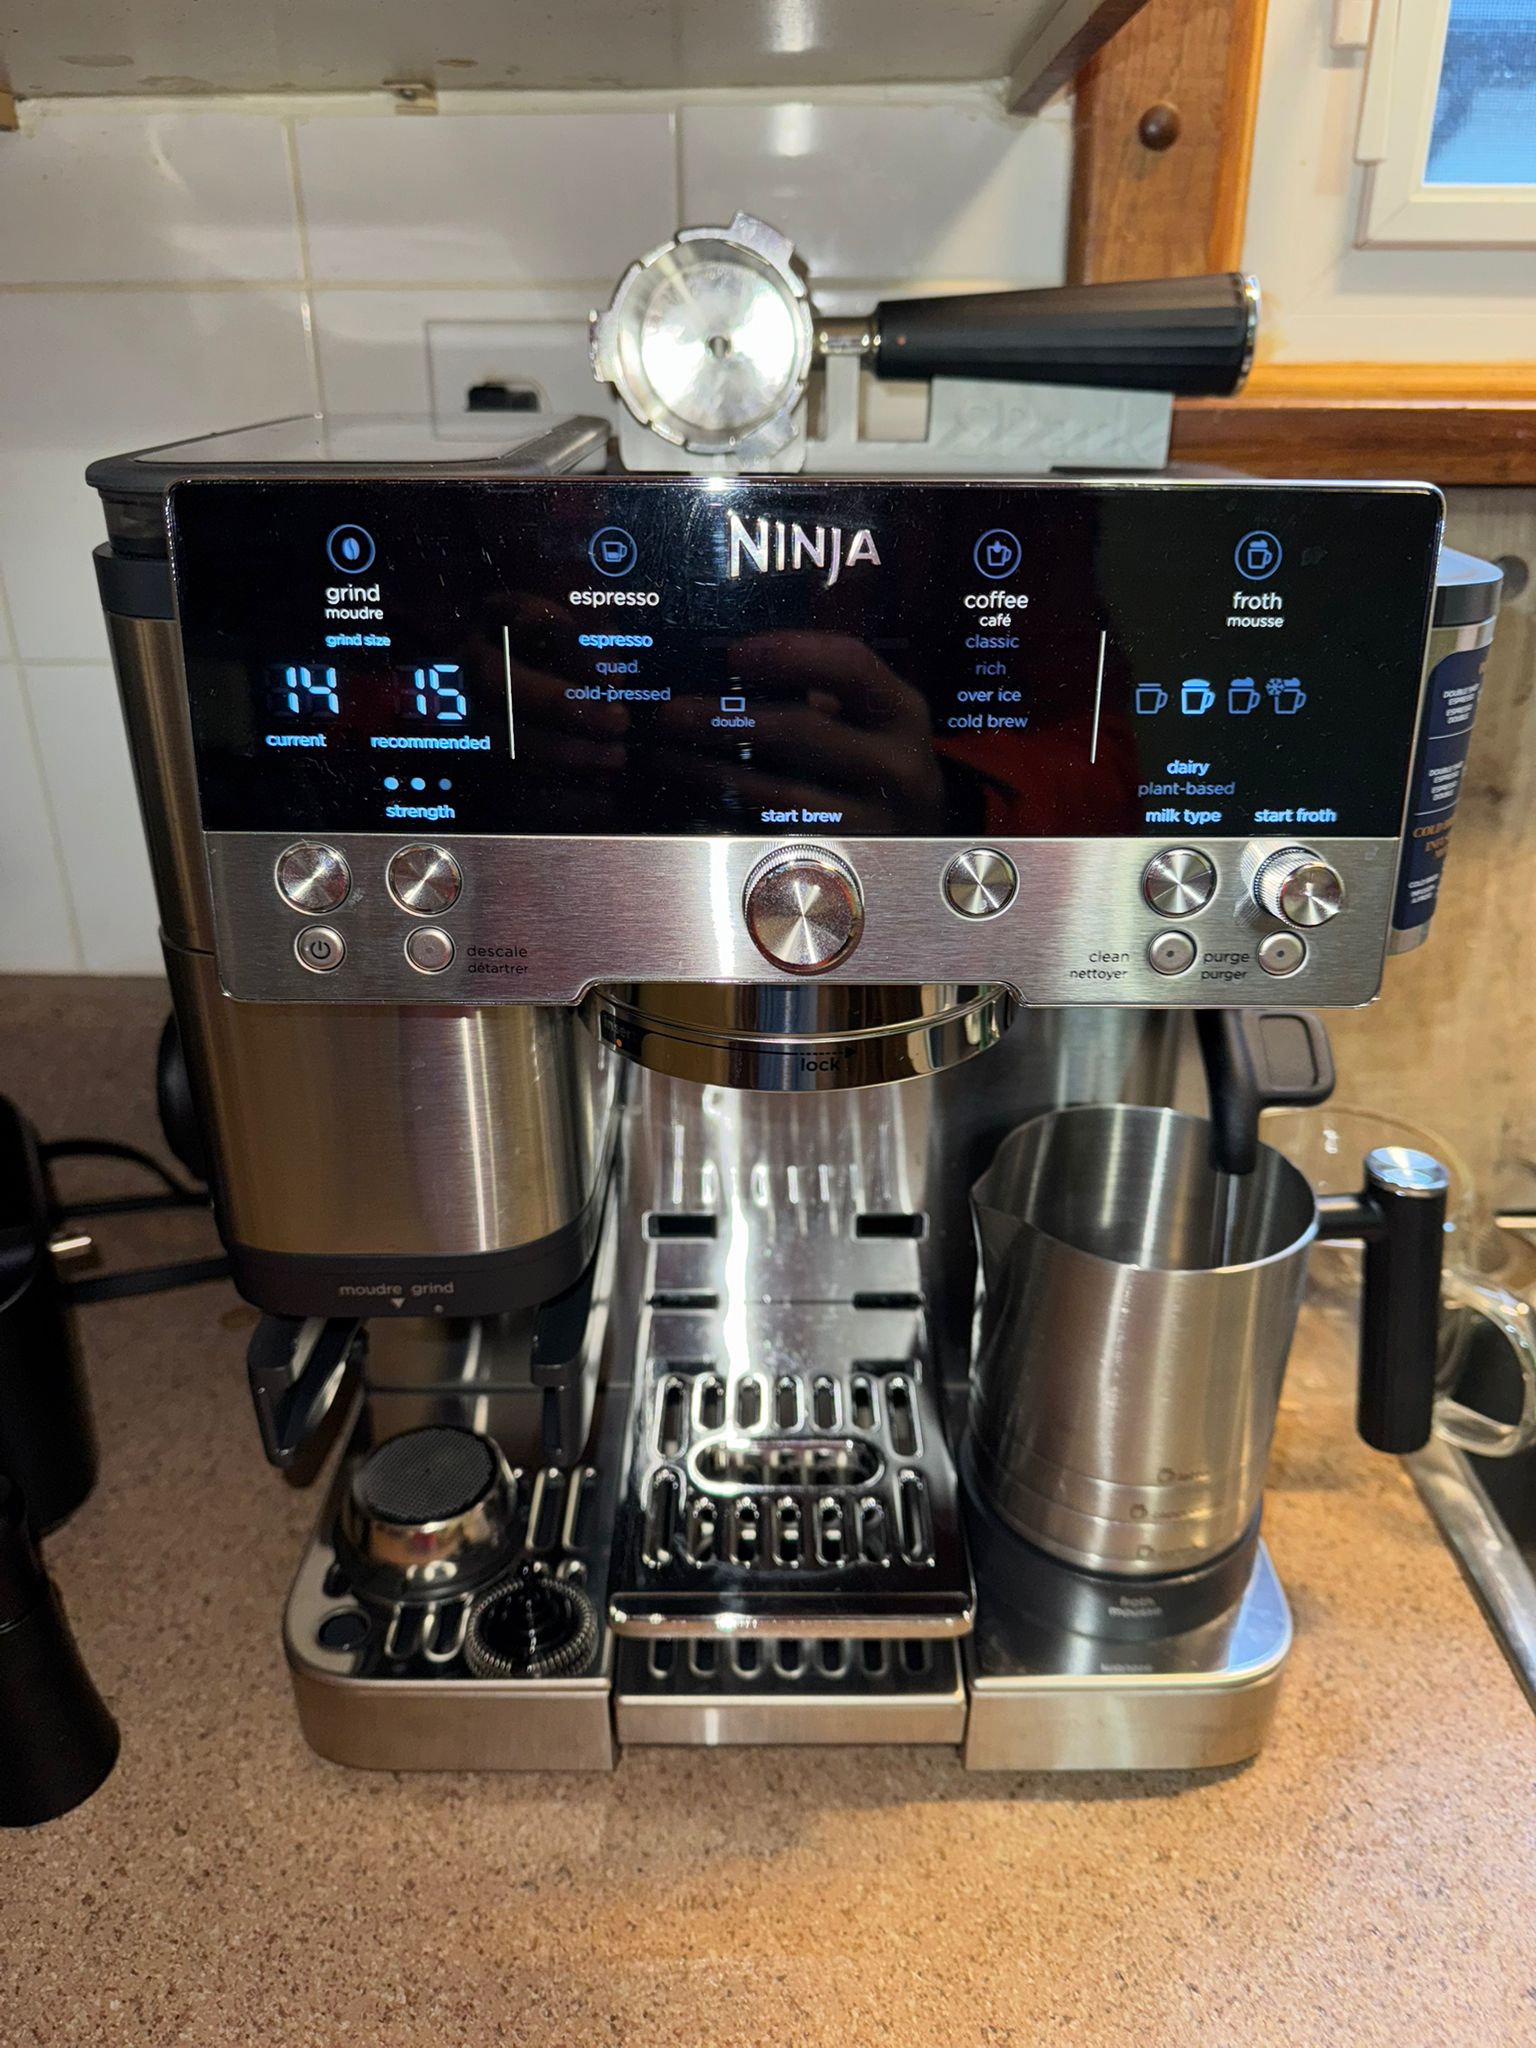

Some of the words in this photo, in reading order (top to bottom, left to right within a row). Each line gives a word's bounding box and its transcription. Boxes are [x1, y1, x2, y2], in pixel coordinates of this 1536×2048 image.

[727, 508, 881, 587] NINJA
[325, 582, 381, 604] grind
[569, 588, 660, 609] espresso
[964, 591, 1029, 609] coffee
[1232, 591, 1283, 610] froth
[324, 605, 384, 620] moudre
[979, 613, 1012, 627] café
[1226, 616, 1285, 628] mousse
[325, 633, 363, 649] grind
[364, 633, 391, 647] size
[578, 634, 654, 650] espresso
[965, 633, 1020, 649] classic
[596, 659, 638, 675] quad
[975, 660, 1006, 675] rich
[284, 666, 340, 715] 14
[413, 663, 468, 721] 15
[565, 684, 671, 703] cold-pressed
[957, 691, 993, 702] over
[997, 688, 1022, 702] ice
[711, 715, 756, 728] double
[948, 713, 983, 728] cold
[986, 713, 1028, 728] brew
[265, 733, 328, 748] current
[370, 734, 491, 750] recommended
[1166, 759, 1210, 777] dairy
[1138, 780, 1236, 797] plant-based
[386, 803, 456, 821] strength
[760, 809, 799, 823] start
[802, 808, 843, 823] brew
[1145, 808, 1181, 822] milk
[1183, 811, 1222, 826] type
[1254, 809, 1295, 823] start
[1296, 807, 1337, 823] froth
[467, 945, 528, 958] descale
[1088, 950, 1130, 963] clean
[1203, 951, 1250, 965] purge
[467, 962, 529, 974] détartrer
[1069, 969, 1128, 981] nettoyer
[1201, 969, 1248, 982] purger
[800, 1057, 840, 1072] lock
[338, 1282, 402, 1296] moudre
[411, 1281, 454, 1297] grind
